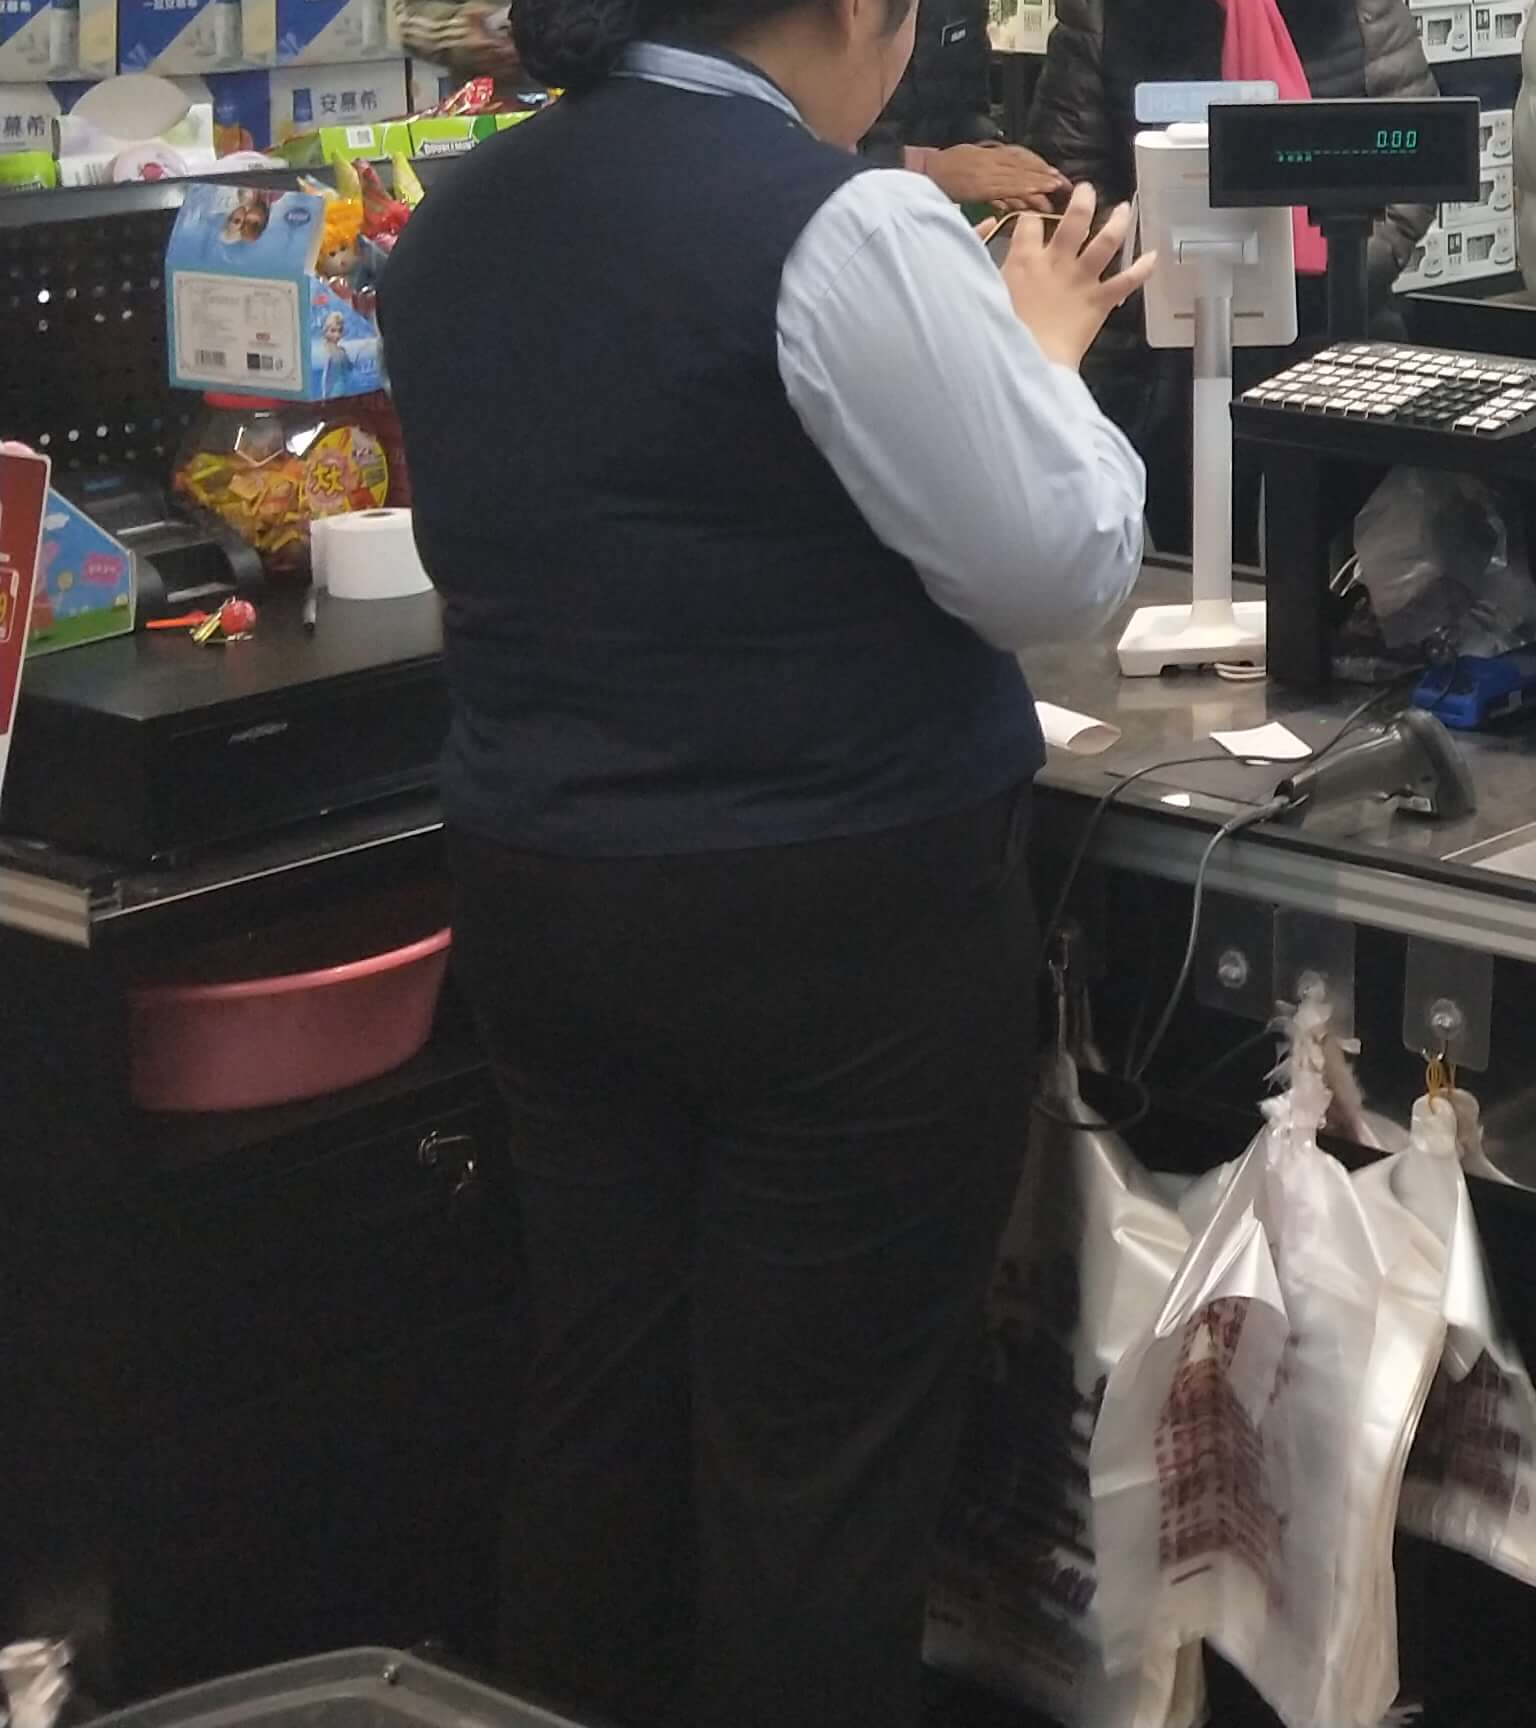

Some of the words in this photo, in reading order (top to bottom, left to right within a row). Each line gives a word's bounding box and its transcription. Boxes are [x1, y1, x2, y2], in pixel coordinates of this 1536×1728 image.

[319, 89, 378, 112] 安慕希
[2, 113, 47, 137] 慕希
